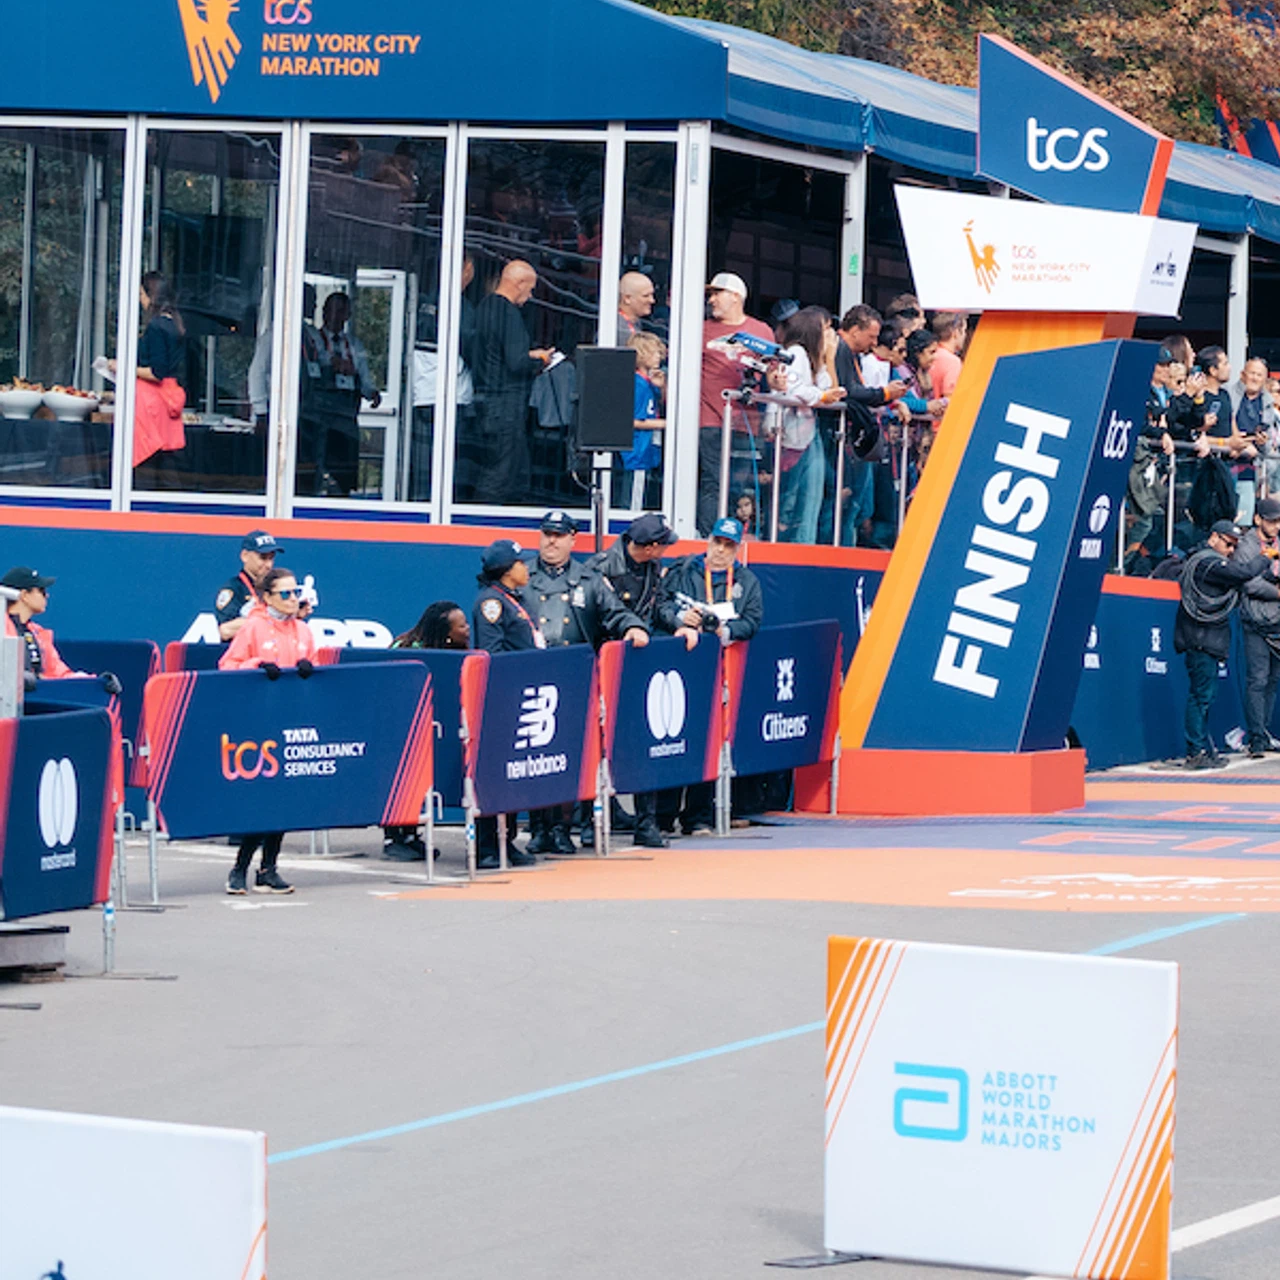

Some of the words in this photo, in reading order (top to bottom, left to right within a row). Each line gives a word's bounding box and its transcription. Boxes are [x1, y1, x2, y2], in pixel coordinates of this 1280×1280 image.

[262, 33, 312, 52] NEW
[315, 34, 371, 53] YORK
[374, 34, 421, 54] CITY
[261, 56, 380, 76] MARATHON
[1026, 117, 1110, 171] tcs
[1012, 245, 1036, 259] tcs
[1103, 410, 1132, 459] tcs
[933, 403, 1071, 699] FINISH
[283, 728, 319, 742] TATA
[763, 713, 808, 741] Citizens
[220, 733, 279, 780] tcs
[283, 741, 366, 760] CONSULTANCY
[284, 759, 337, 776] SERVICES
[507, 758, 527, 780] new
[527, 753, 567, 775] balance
[982, 1071, 1058, 1092] ABBOTT
[982, 1090, 1051, 1111] WORLD
[981, 1111, 1096, 1134] MARATHON
[981, 1131, 1062, 1152] MAJORS
